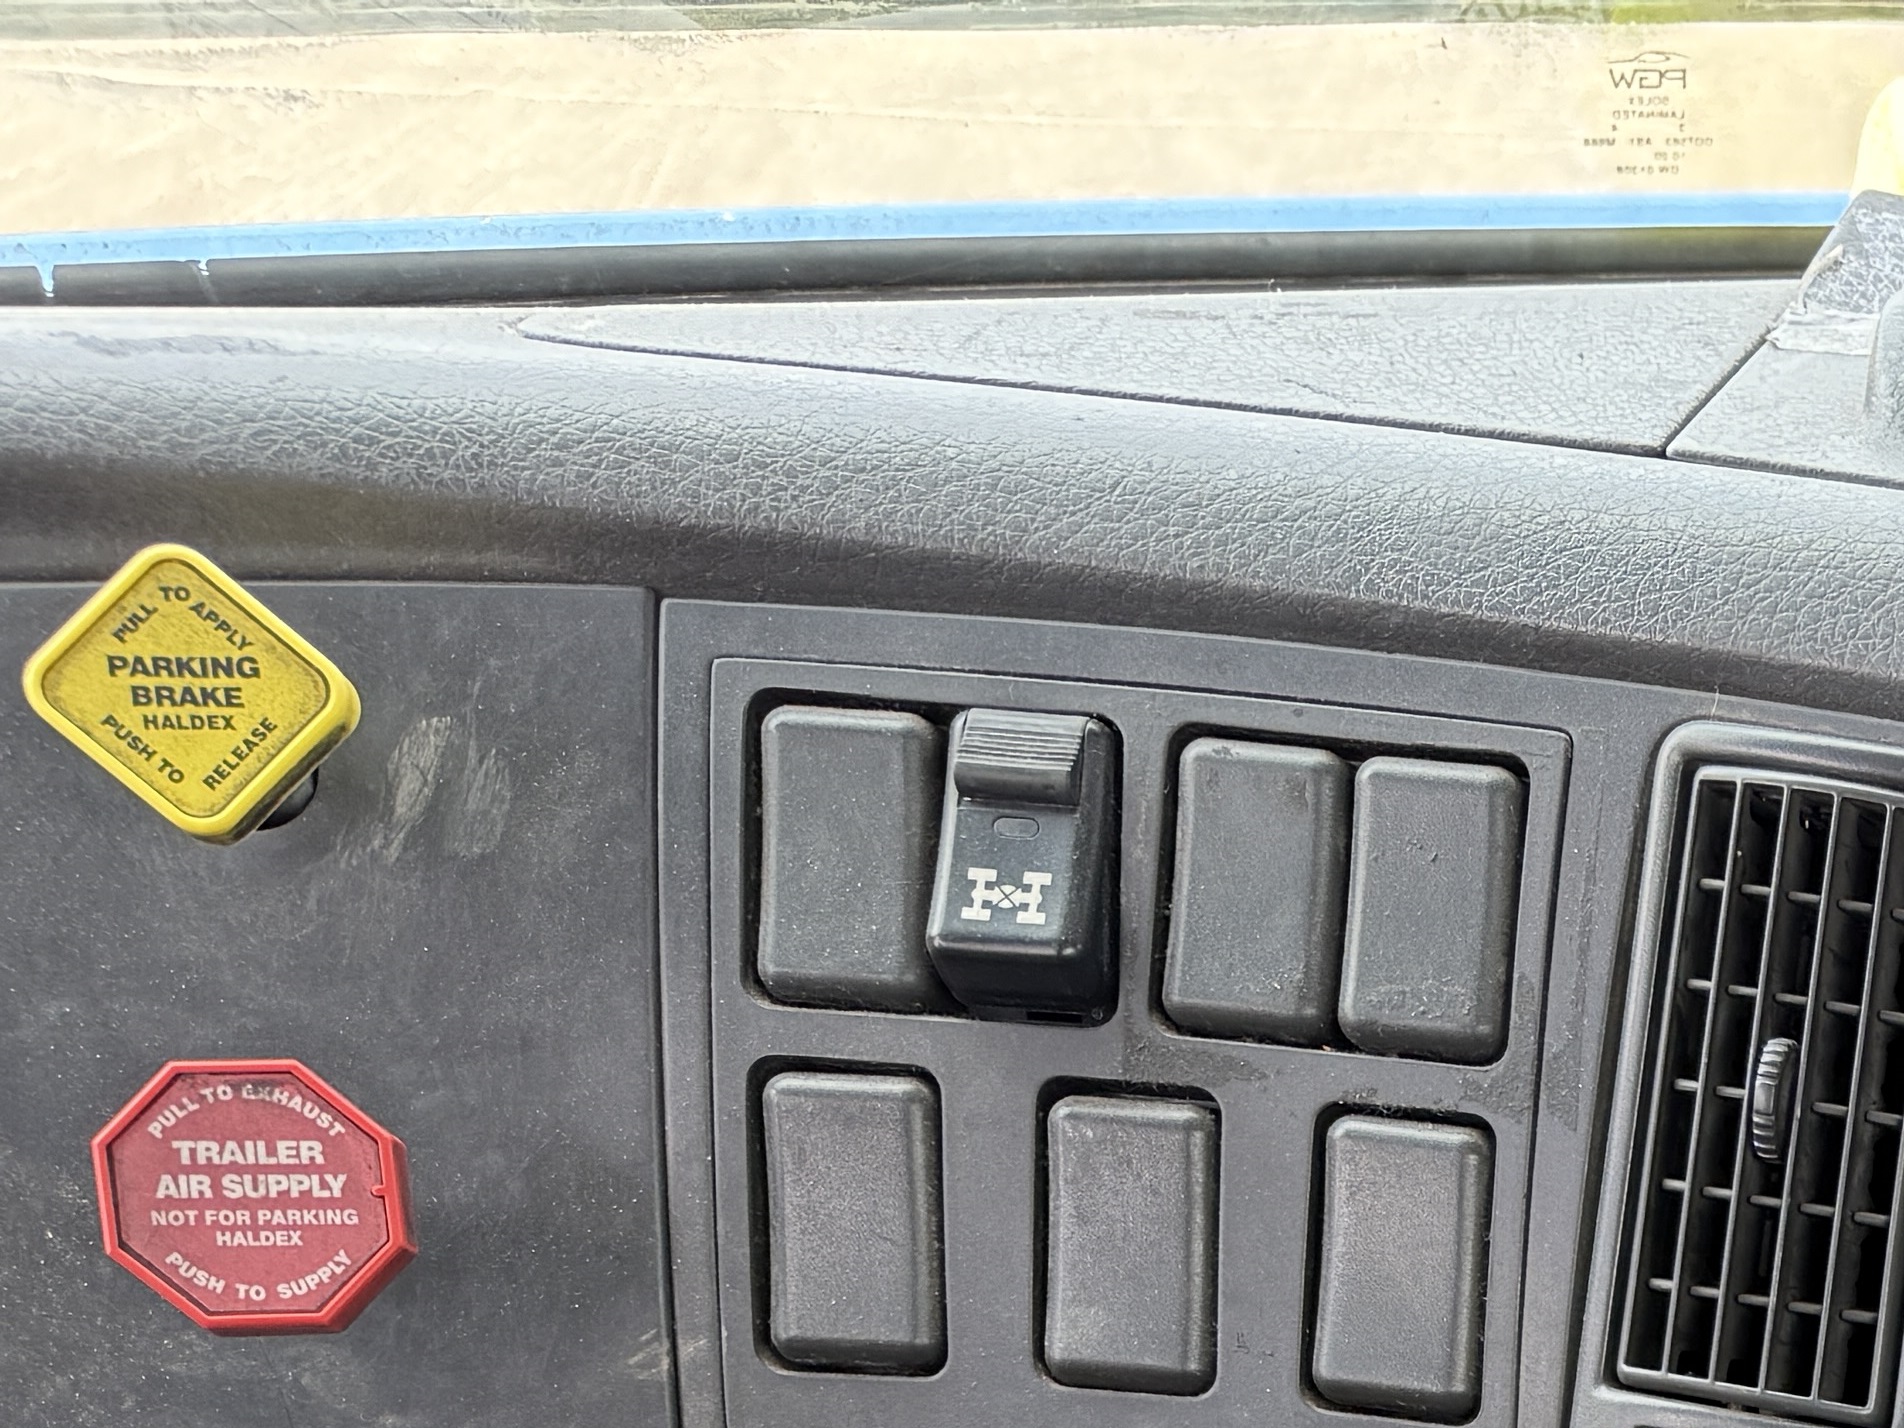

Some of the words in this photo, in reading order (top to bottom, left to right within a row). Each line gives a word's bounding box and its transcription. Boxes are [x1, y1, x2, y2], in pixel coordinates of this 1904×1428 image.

[111, 604, 159, 644] PULL
[158, 586, 190, 602] TO
[189, 602, 255, 651] APPLY
[107, 655, 261, 680] PARKING
[131, 685, 246, 709] BRAKE
[143, 714, 237, 731] HALDEX
[101, 714, 157, 762] PUSH
[157, 757, 185, 784] TO
[202, 717, 279, 791] RELEASE
[147, 1097, 200, 1139] PULL
[199, 1084, 233, 1104] TO
[242, 1083, 346, 1136] EXHAUST
[171, 1139, 326, 1165] TRAILER
[155, 1174, 214, 1199] AIR
[221, 1173, 348, 1199] SUPPLY
[150, 1209, 199, 1226] NOT
[204, 1209, 251, 1226] FOR
[257, 1208, 360, 1225] PARKING
[215, 1230, 303, 1247] HALDEX
[164, 1251, 226, 1294] PUSH
[235, 1283, 266, 1301] TO
[276, 1249, 352, 1299] SUPPLY
